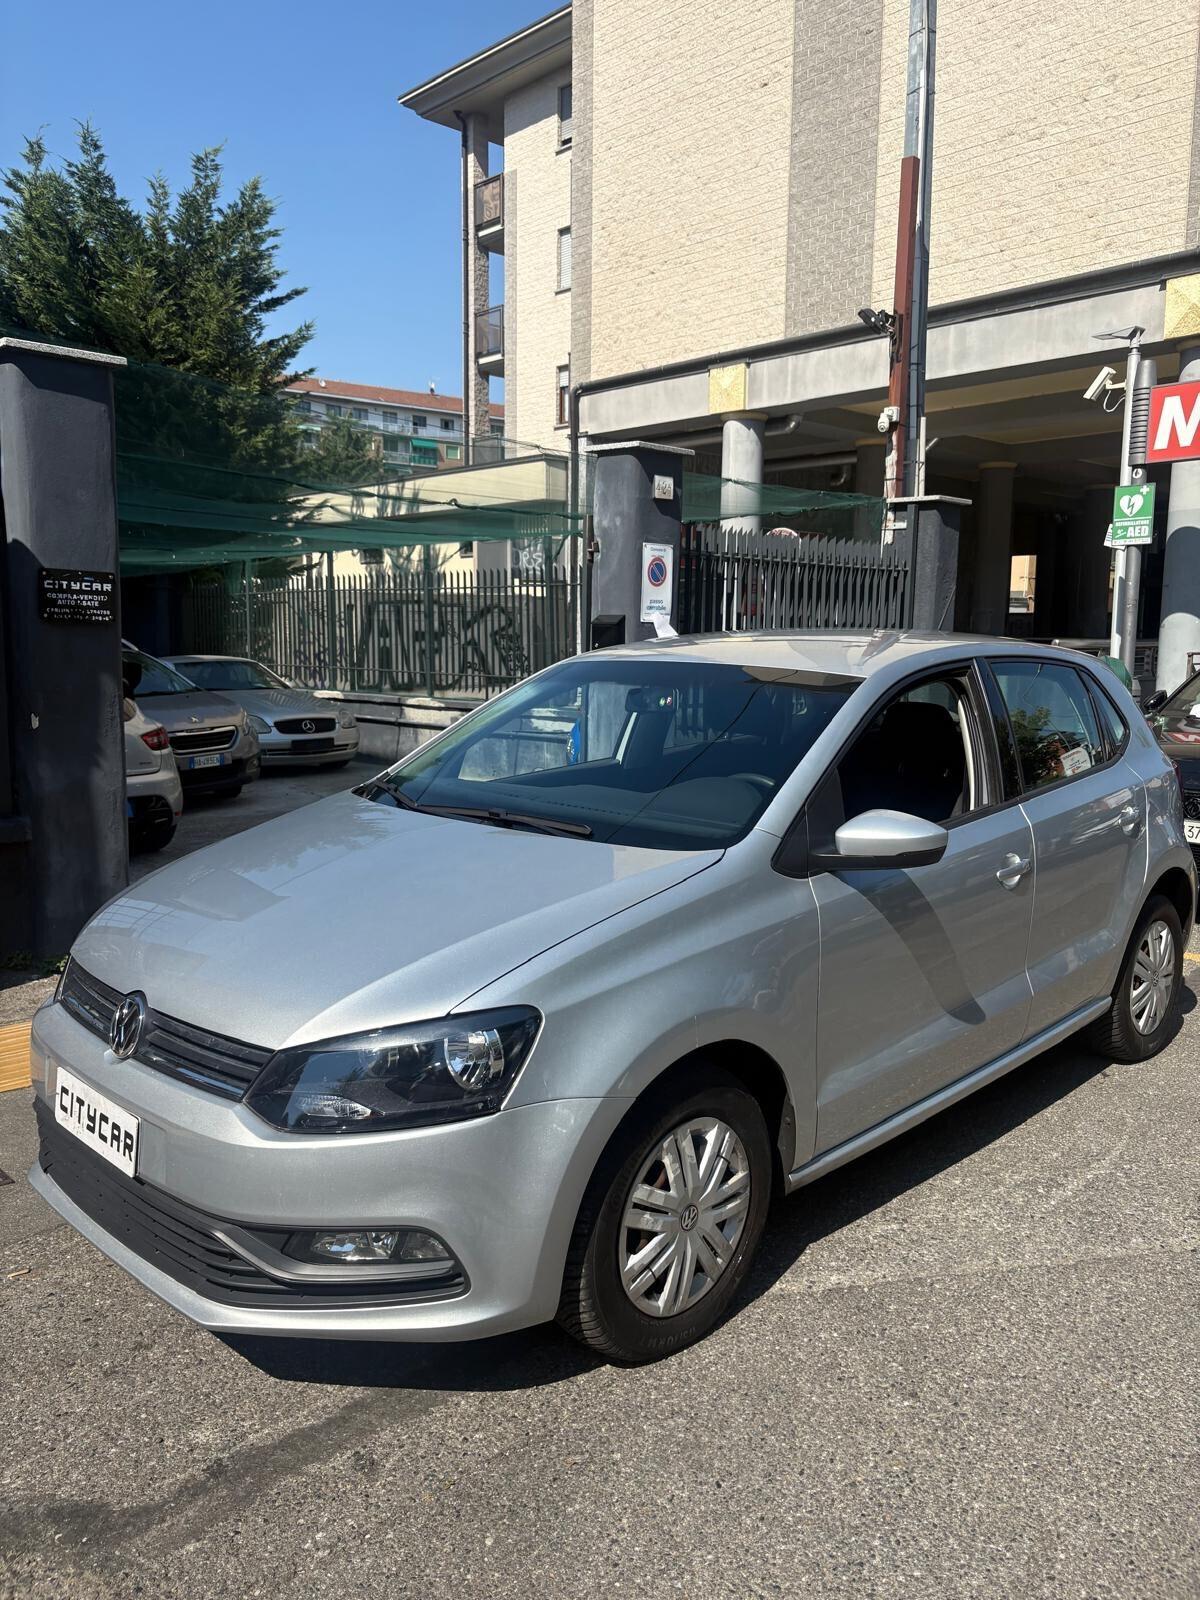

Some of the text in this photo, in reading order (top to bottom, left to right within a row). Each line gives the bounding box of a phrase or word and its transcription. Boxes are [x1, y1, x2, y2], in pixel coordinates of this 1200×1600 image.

[1153, 391, 1200, 450] M
[1126, 526, 1149, 538] AED
[44, 580, 112, 591] CITYCAR
[60, 1085, 134, 1163] CITYCAR
